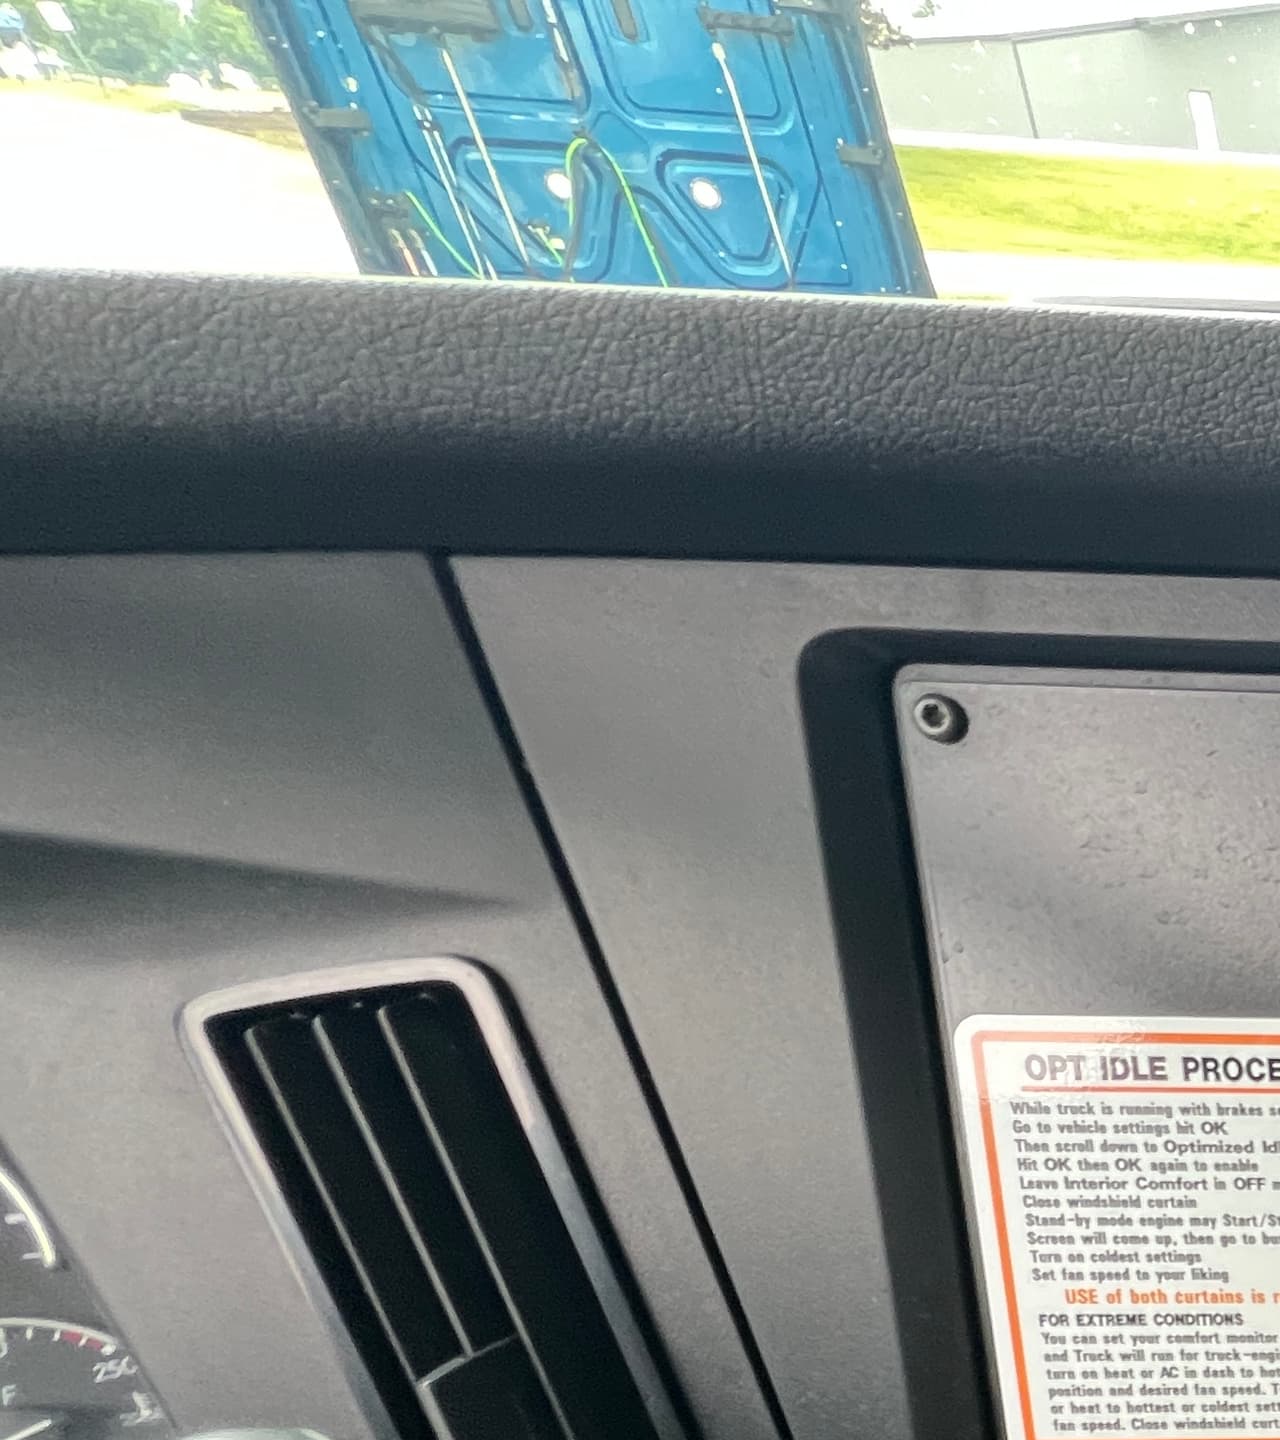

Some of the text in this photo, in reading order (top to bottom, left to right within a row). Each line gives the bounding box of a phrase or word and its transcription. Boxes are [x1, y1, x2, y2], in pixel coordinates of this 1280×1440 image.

[1100, 1055, 1169, 1081] IDLE
[1013, 1120, 1031, 1133] Go
[1036, 1121, 1052, 1133] to
[1057, 1120, 1107, 1134] vehicle
[1112, 1120, 1171, 1137] settings
[1200, 1121, 1228, 1135] OK
[1014, 1139, 1050, 1152] Then
[1055, 1139, 1094, 1152] scroll
[1100, 1139, 1138, 1153] down
[1142, 1141, 1158, 1153] to
[1163, 1139, 1255, 1156] Optimized
[1043, 1157, 1072, 1171] OK
[1077, 1158, 1109, 1171] then
[1114, 1158, 1142, 1172] OK
[1150, 1158, 1188, 1175] again
[1193, 1160, 1208, 1172] to
[1020, 1176, 1058, 1190] Leave
[1064, 1176, 1128, 1190] Interior
[1135, 1176, 1208, 1190] Comfort
[1213, 1176, 1226, 1190] in
[1233, 1177, 1266, 1191] OFF
[1022, 1195, 1197, 1208] Close windshield curtain
[1097, 1213, 1133, 1227] mode
[1139, 1213, 1184, 1230] engine
[1189, 1217, 1217, 1230] may
[1027, 1231, 1075, 1245] Screen
[1080, 1232, 1107, 1245] will
[1112, 1235, 1150, 1245] come
[1182, 1232, 1214, 1245] then
[1220, 1235, 1237, 1248] go
[1242, 1233, 1256, 1244] to
[1029, 1250, 1202, 1266] Turn on coldest settings
[1032, 1268, 1056, 1281] Set
[1061, 1267, 1084, 1281] fan
[1089, 1268, 1130, 1284] speed
[1135, 1269, 1150, 1280] to
[1155, 1271, 1186, 1284] your
[1065, 1288, 1099, 1304] USE
[1106, 1288, 1122, 1304] of
[1129, 1288, 1168, 1304] both
[1174, 1289, 1244, 1304] curtains
[1251, 1289, 1265, 1304] is
[1039, 1313, 1244, 1327] FOR EXTREME CONDITIONS
